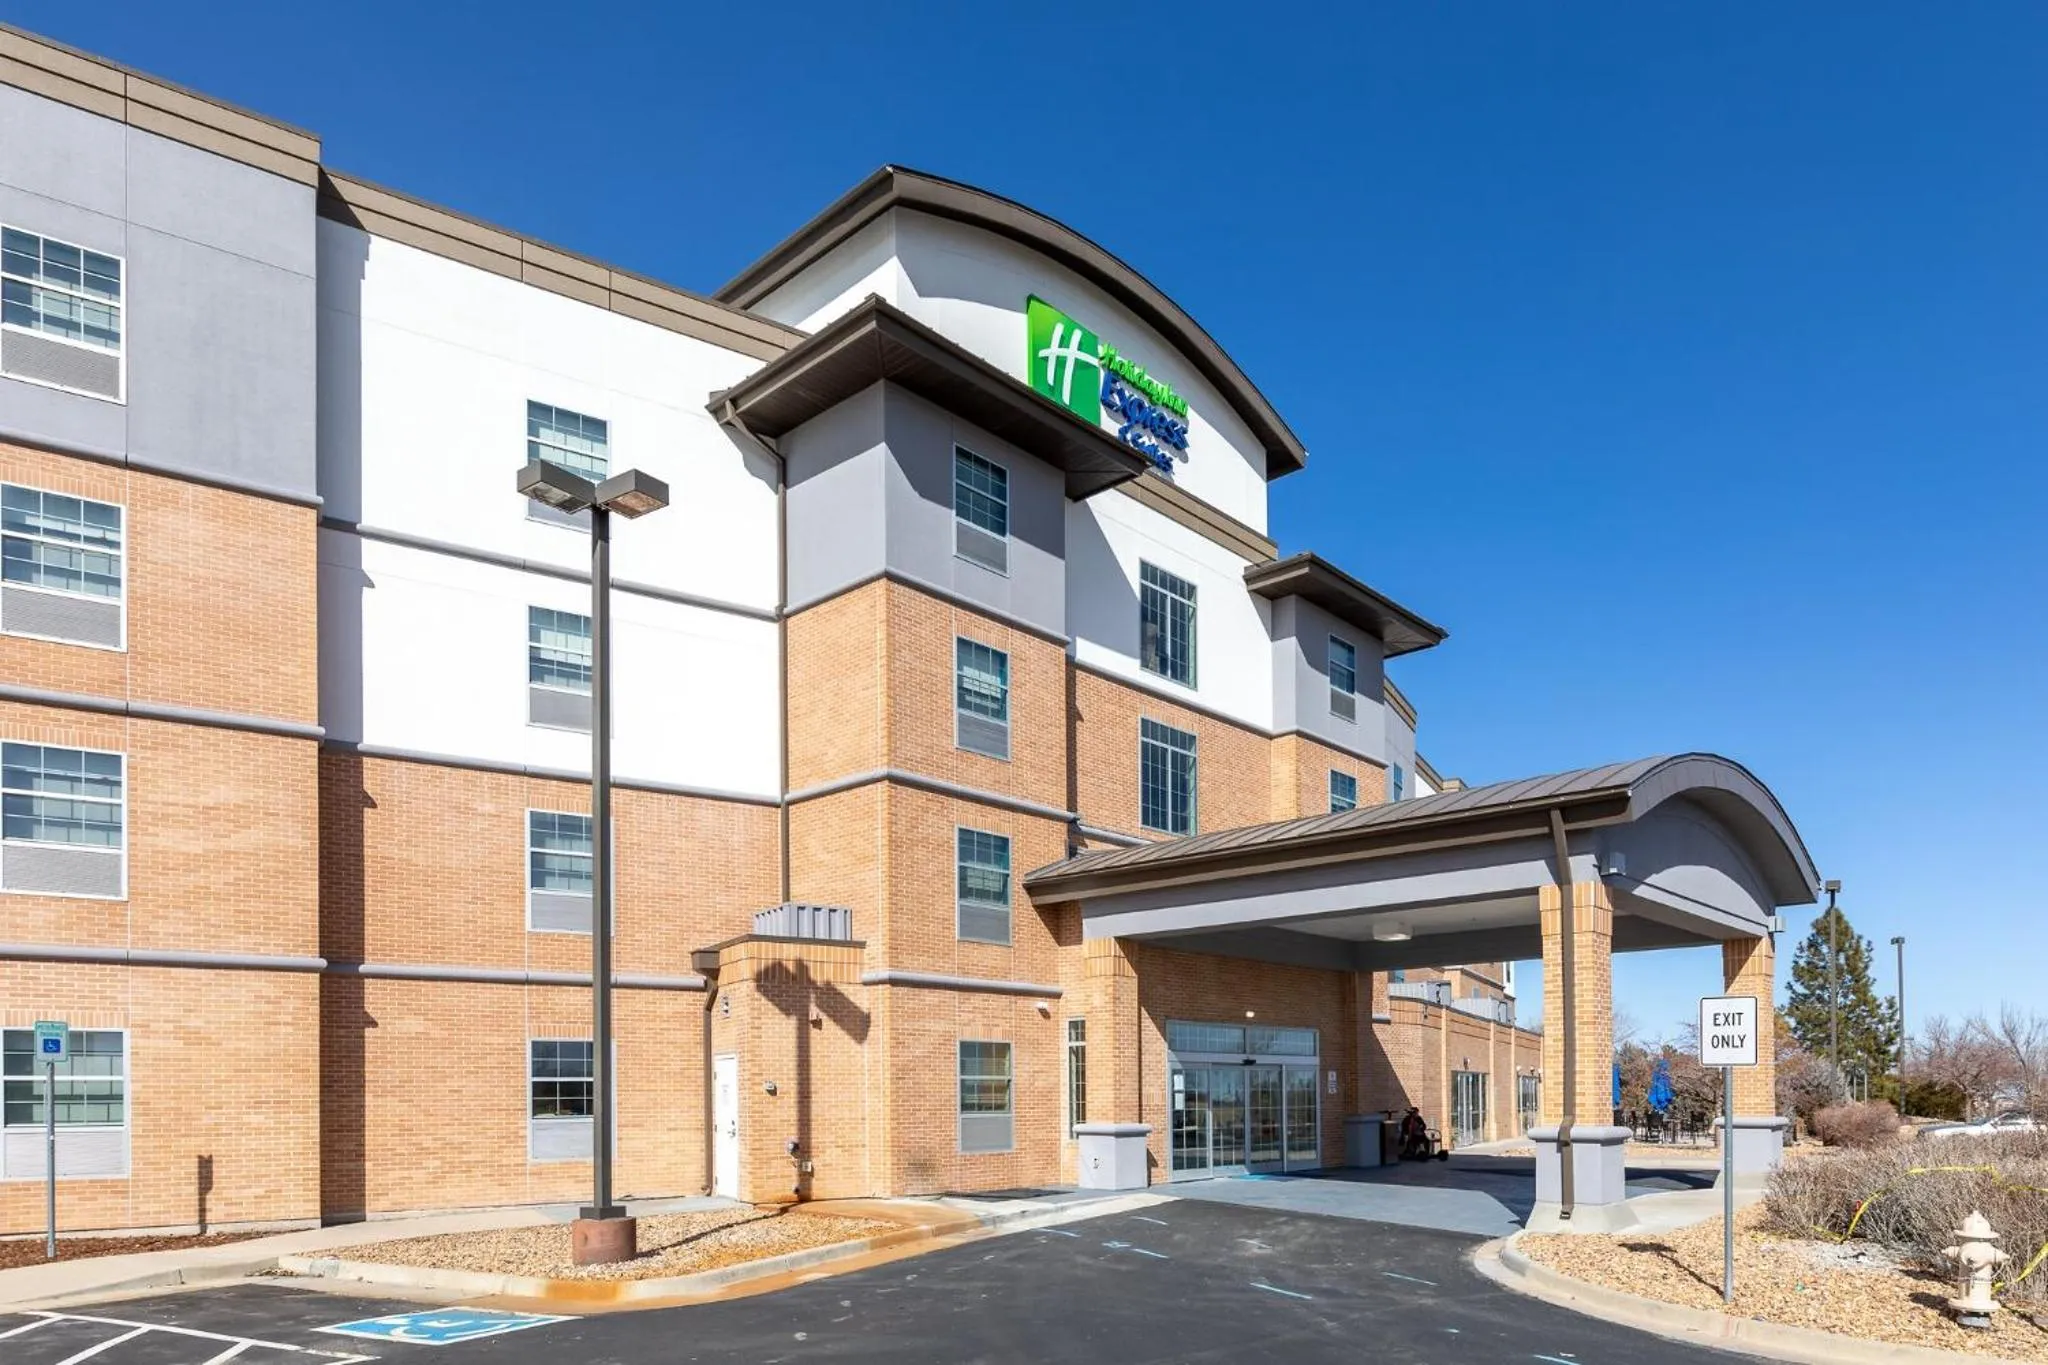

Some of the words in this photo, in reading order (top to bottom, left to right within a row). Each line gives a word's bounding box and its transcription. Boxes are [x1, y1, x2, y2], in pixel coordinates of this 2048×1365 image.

[1099, 343, 1163, 405] Holiday
[1160, 384, 1189, 418] Inn
[1101, 370, 1190, 450] Express
[1711, 1034, 1746, 1049] ONLY
[1713, 1012, 1744, 1026] EXIT
